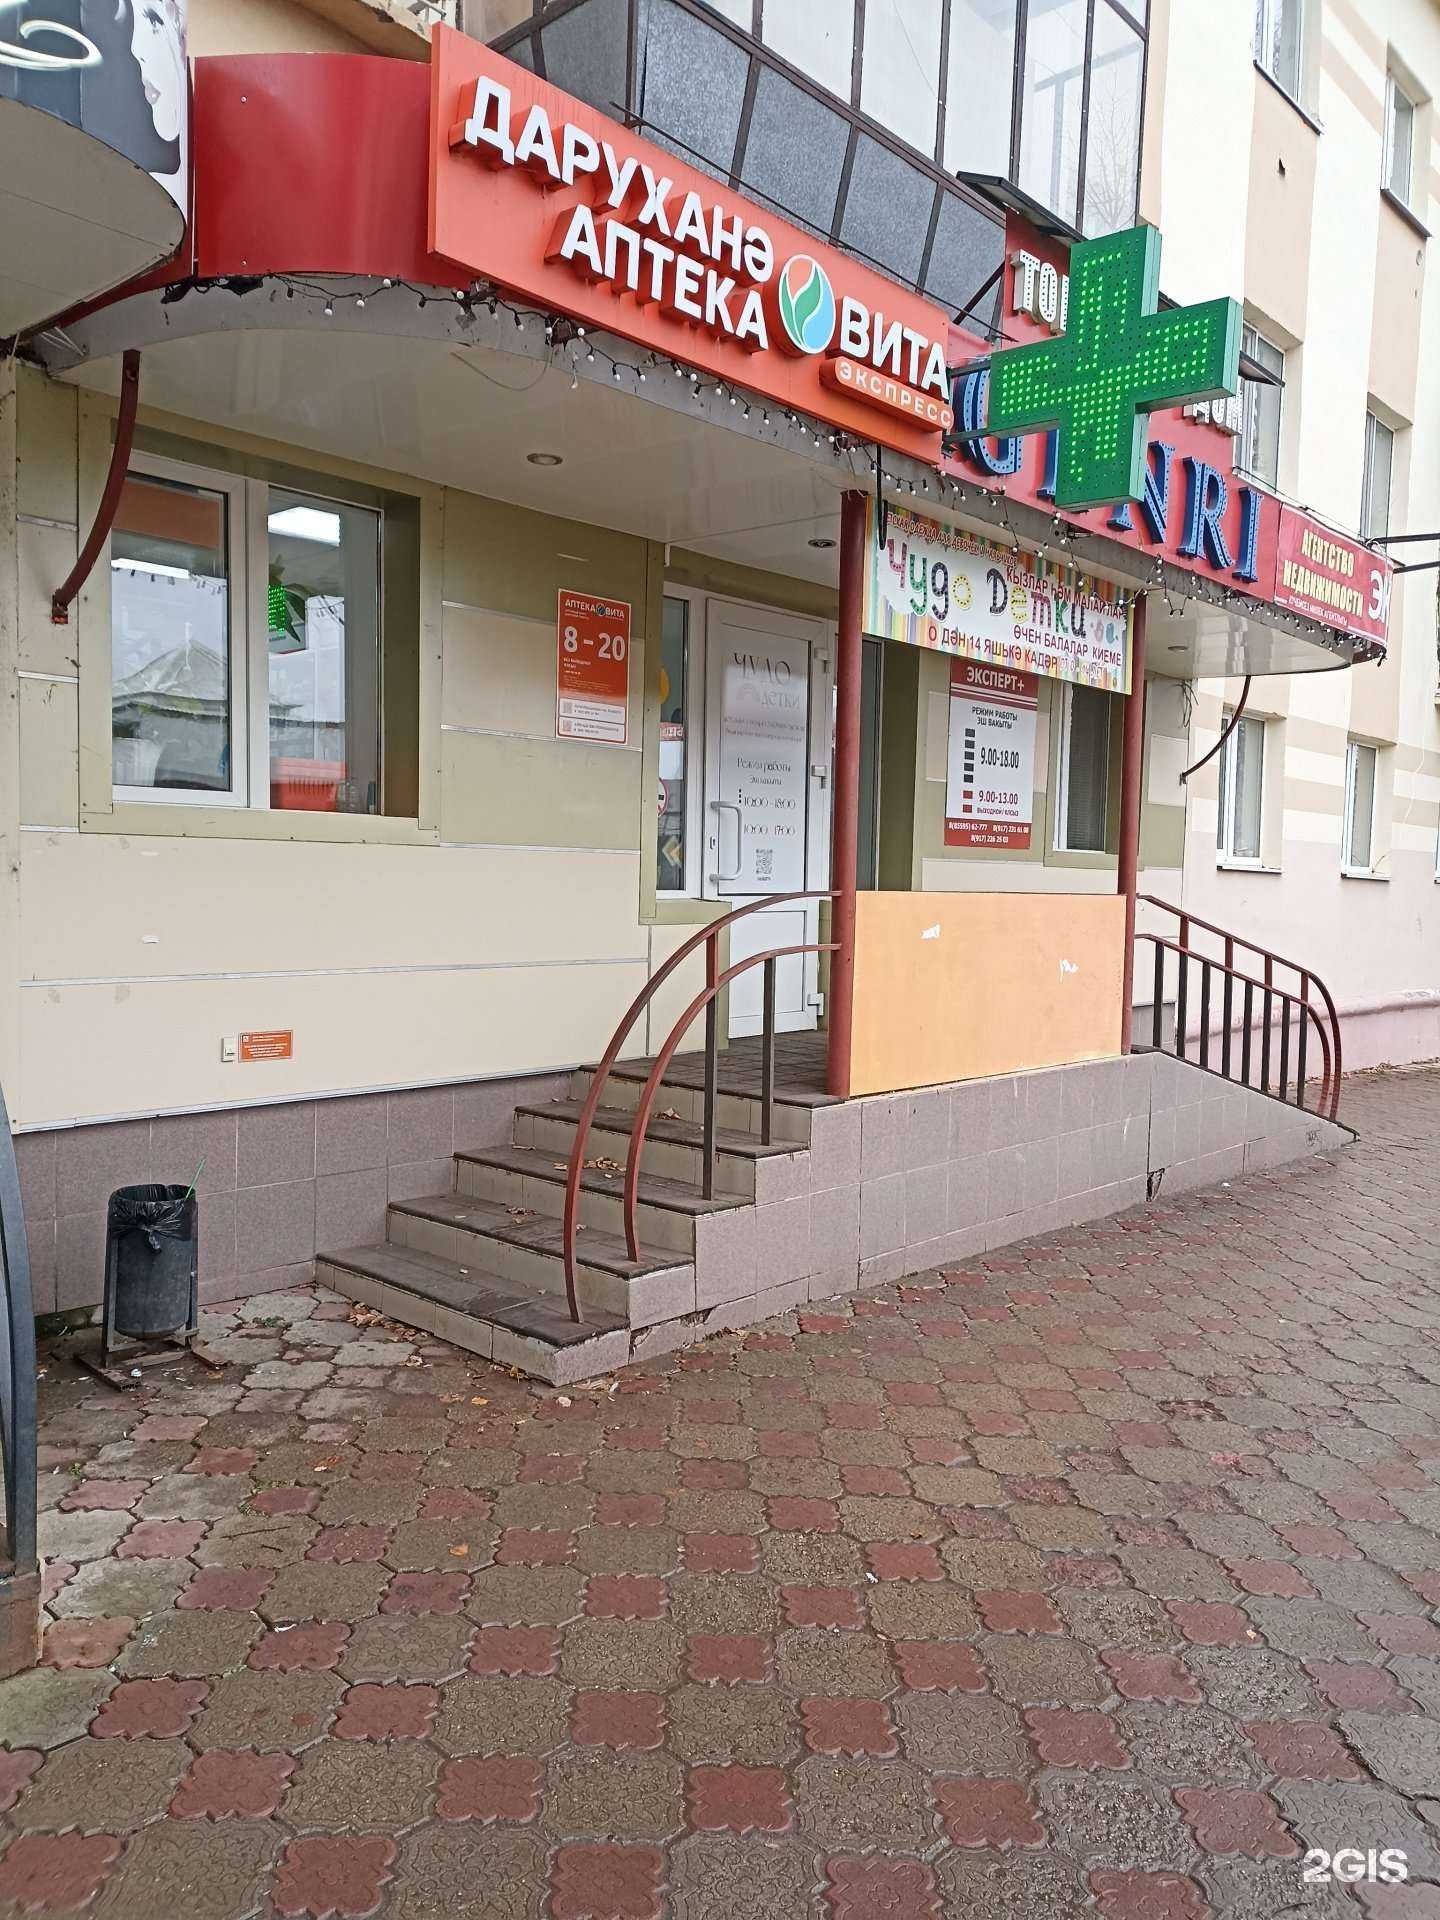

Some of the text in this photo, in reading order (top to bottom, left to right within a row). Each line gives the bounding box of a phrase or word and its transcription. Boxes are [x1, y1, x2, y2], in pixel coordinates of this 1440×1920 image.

[464, 75, 774, 283] ДАРУХАНӘ
[560, 203, 769, 350] АПТЕКА
[840, 295, 949, 400] ВИТА
[839, 360, 952, 428] ЭКСПРЕСС
[1302, 528, 1355, 578] АГЕНТСТВО
[886, 538, 974, 622] Чудо
[1006, 564, 1049, 593] КЫЗЛАР
[1282, 559, 1364, 618] НЕДВИЖИМОСТИ
[565, 599, 625, 619] АПТЕКА ВИТА
[564, 626, 578, 653] 8
[598, 632, 626, 661] 20
[941, 628, 966, 648] ДӘН
[969, 636, 981, 650] 14
[984, 638, 1022, 661] ЯШЬКӘ
[1024, 649, 1058, 671] КАДӘР
[1013, 624, 1122, 667] ӨЧЕН БАЛАЛАР КИЕМЕ
[966, 665, 1025, 693] ЭКСПЕРТ+
[972, 706, 1018, 722] РЕЖИМ РАБОТЫ
[977, 716, 1013, 730] ЭШ ВАКЫТЫ
[980, 747, 1020, 769] 9.00-18.00
[978, 790, 1019, 805] 9.00-13.00
